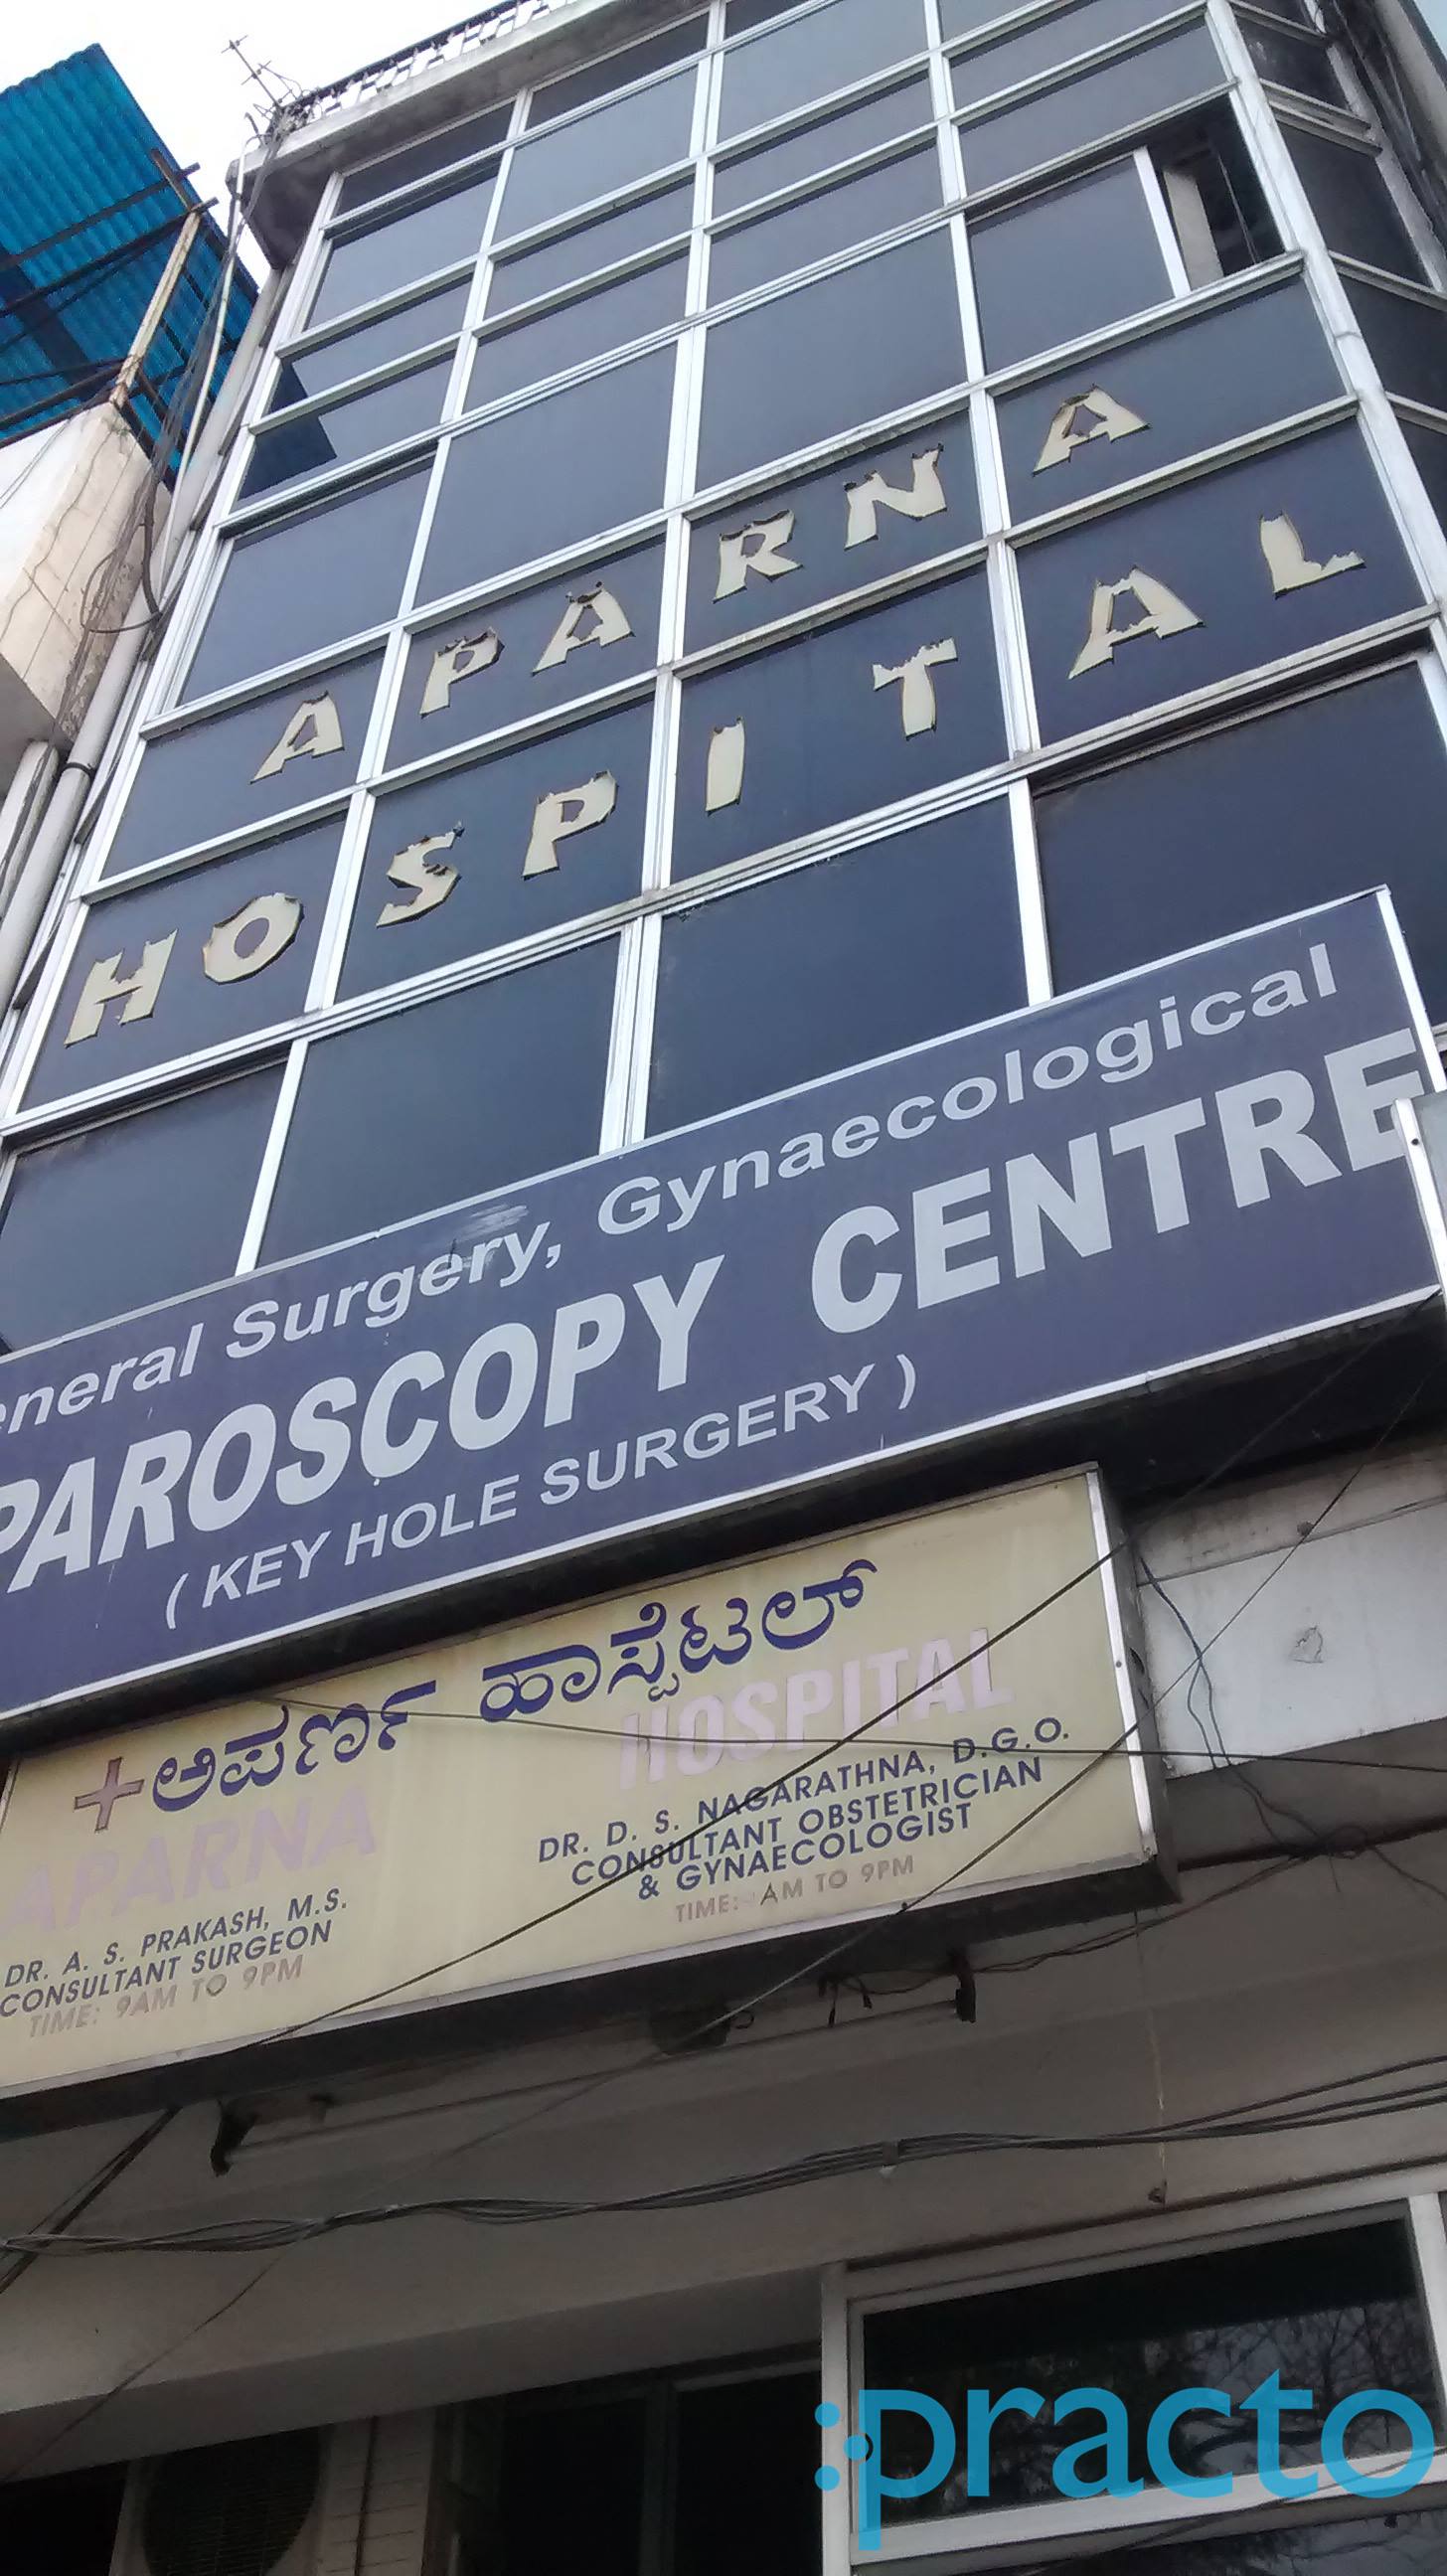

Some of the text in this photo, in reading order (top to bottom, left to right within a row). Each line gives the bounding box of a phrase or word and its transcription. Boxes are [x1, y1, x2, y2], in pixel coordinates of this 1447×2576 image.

[250, 385, 1151, 784] APARNA
[63, 511, 1366, 1047] HOSPITAL
[0, 942, 1338, 1435] neral Surgery, Gynaecological
[810, 1027, 1426, 1335] CENTRE
[343, 1474, 520, 1566] HOLE
[4, 1627, 1016, 1934] APARNA HOSPITAL
[538, 1716, 1070, 1863] DR. D. S. NAGARATHNA, D.G.O.
[570, 1755, 1043, 1886] CONSULTANT OBSTETRICIAN
[638, 1802, 973, 1901] & GYNAECOLOGIST
[815, 1869, 849, 1893] TO
[860, 1853, 914, 1883] 9PM
[0, 1919, 333, 2017] CONSULTANT SURGEON
[5, 1887, 348, 1988] DR. A. S. PRAKASH, M.S.
[28, 1953, 304, 2038] TIME: 9AM TO 9PM
